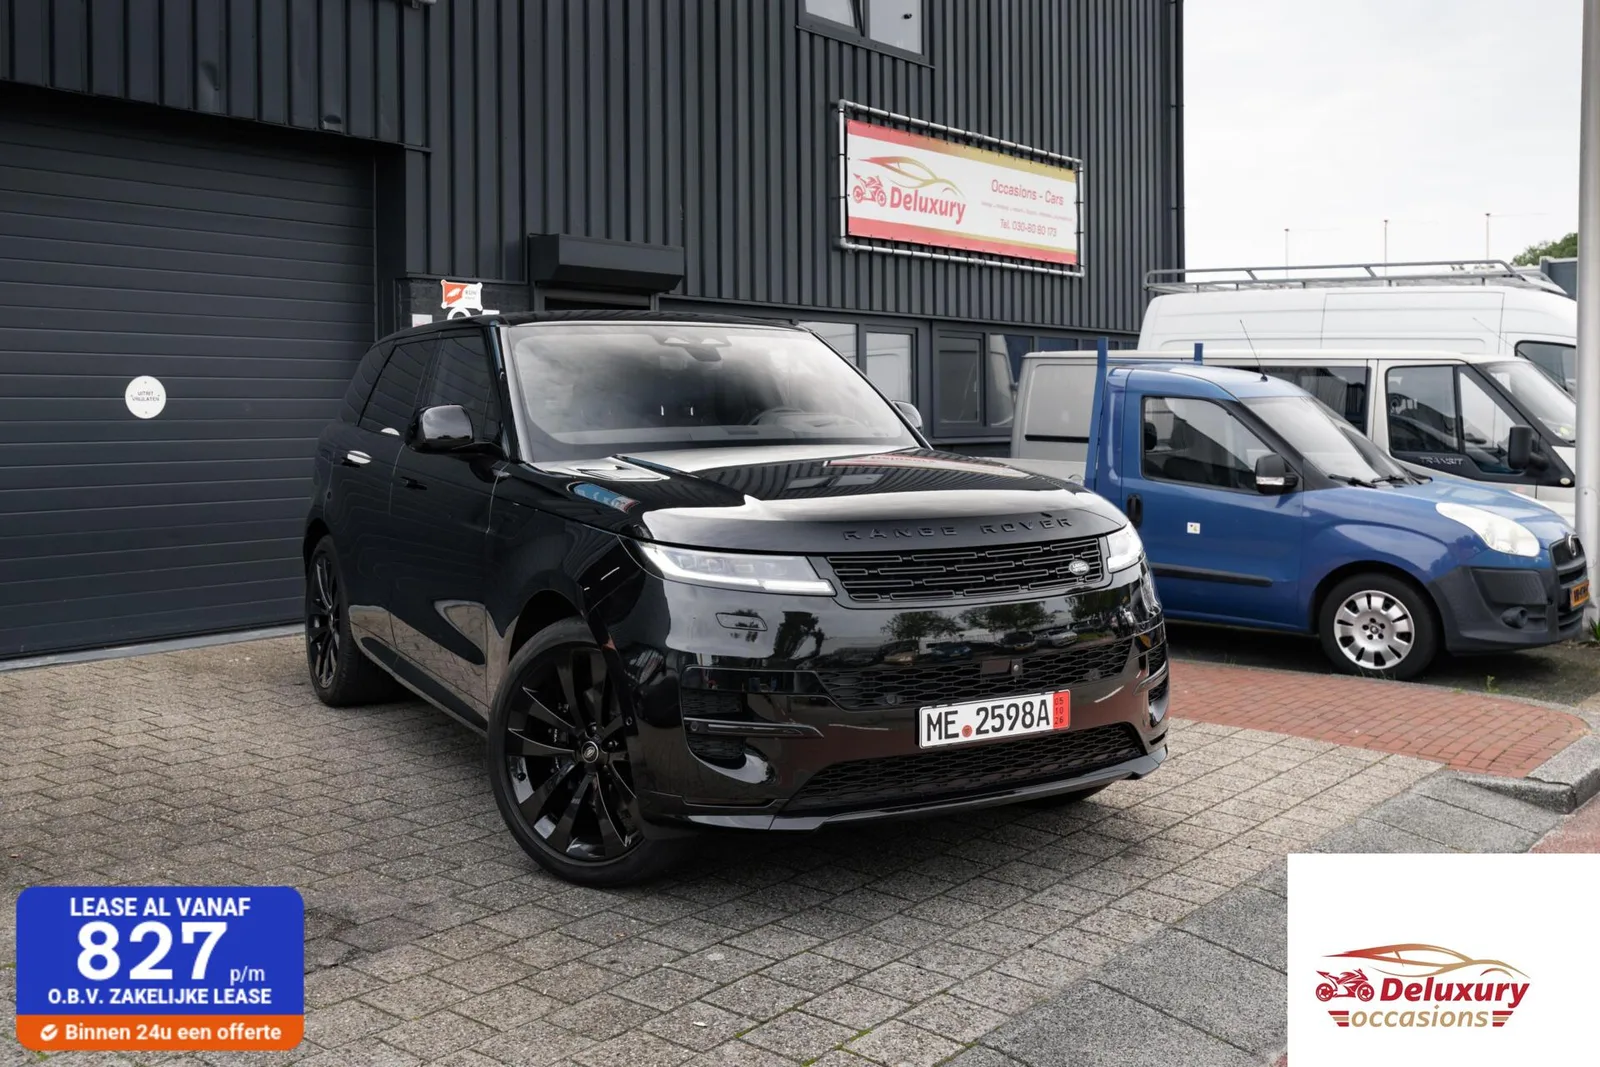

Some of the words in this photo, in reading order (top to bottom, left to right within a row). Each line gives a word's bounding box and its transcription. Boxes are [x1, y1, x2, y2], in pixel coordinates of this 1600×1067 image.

[890, 187, 966, 225] Deluxury
[991, 179, 1037, 201] Occasions
[1045, 190, 1064, 206] Cars
[843, 526, 958, 540] RANGE
[980, 517, 1073, 534] ROVER
[927, 710, 960, 742] ME
[975, 699, 1051, 736] 2598A
